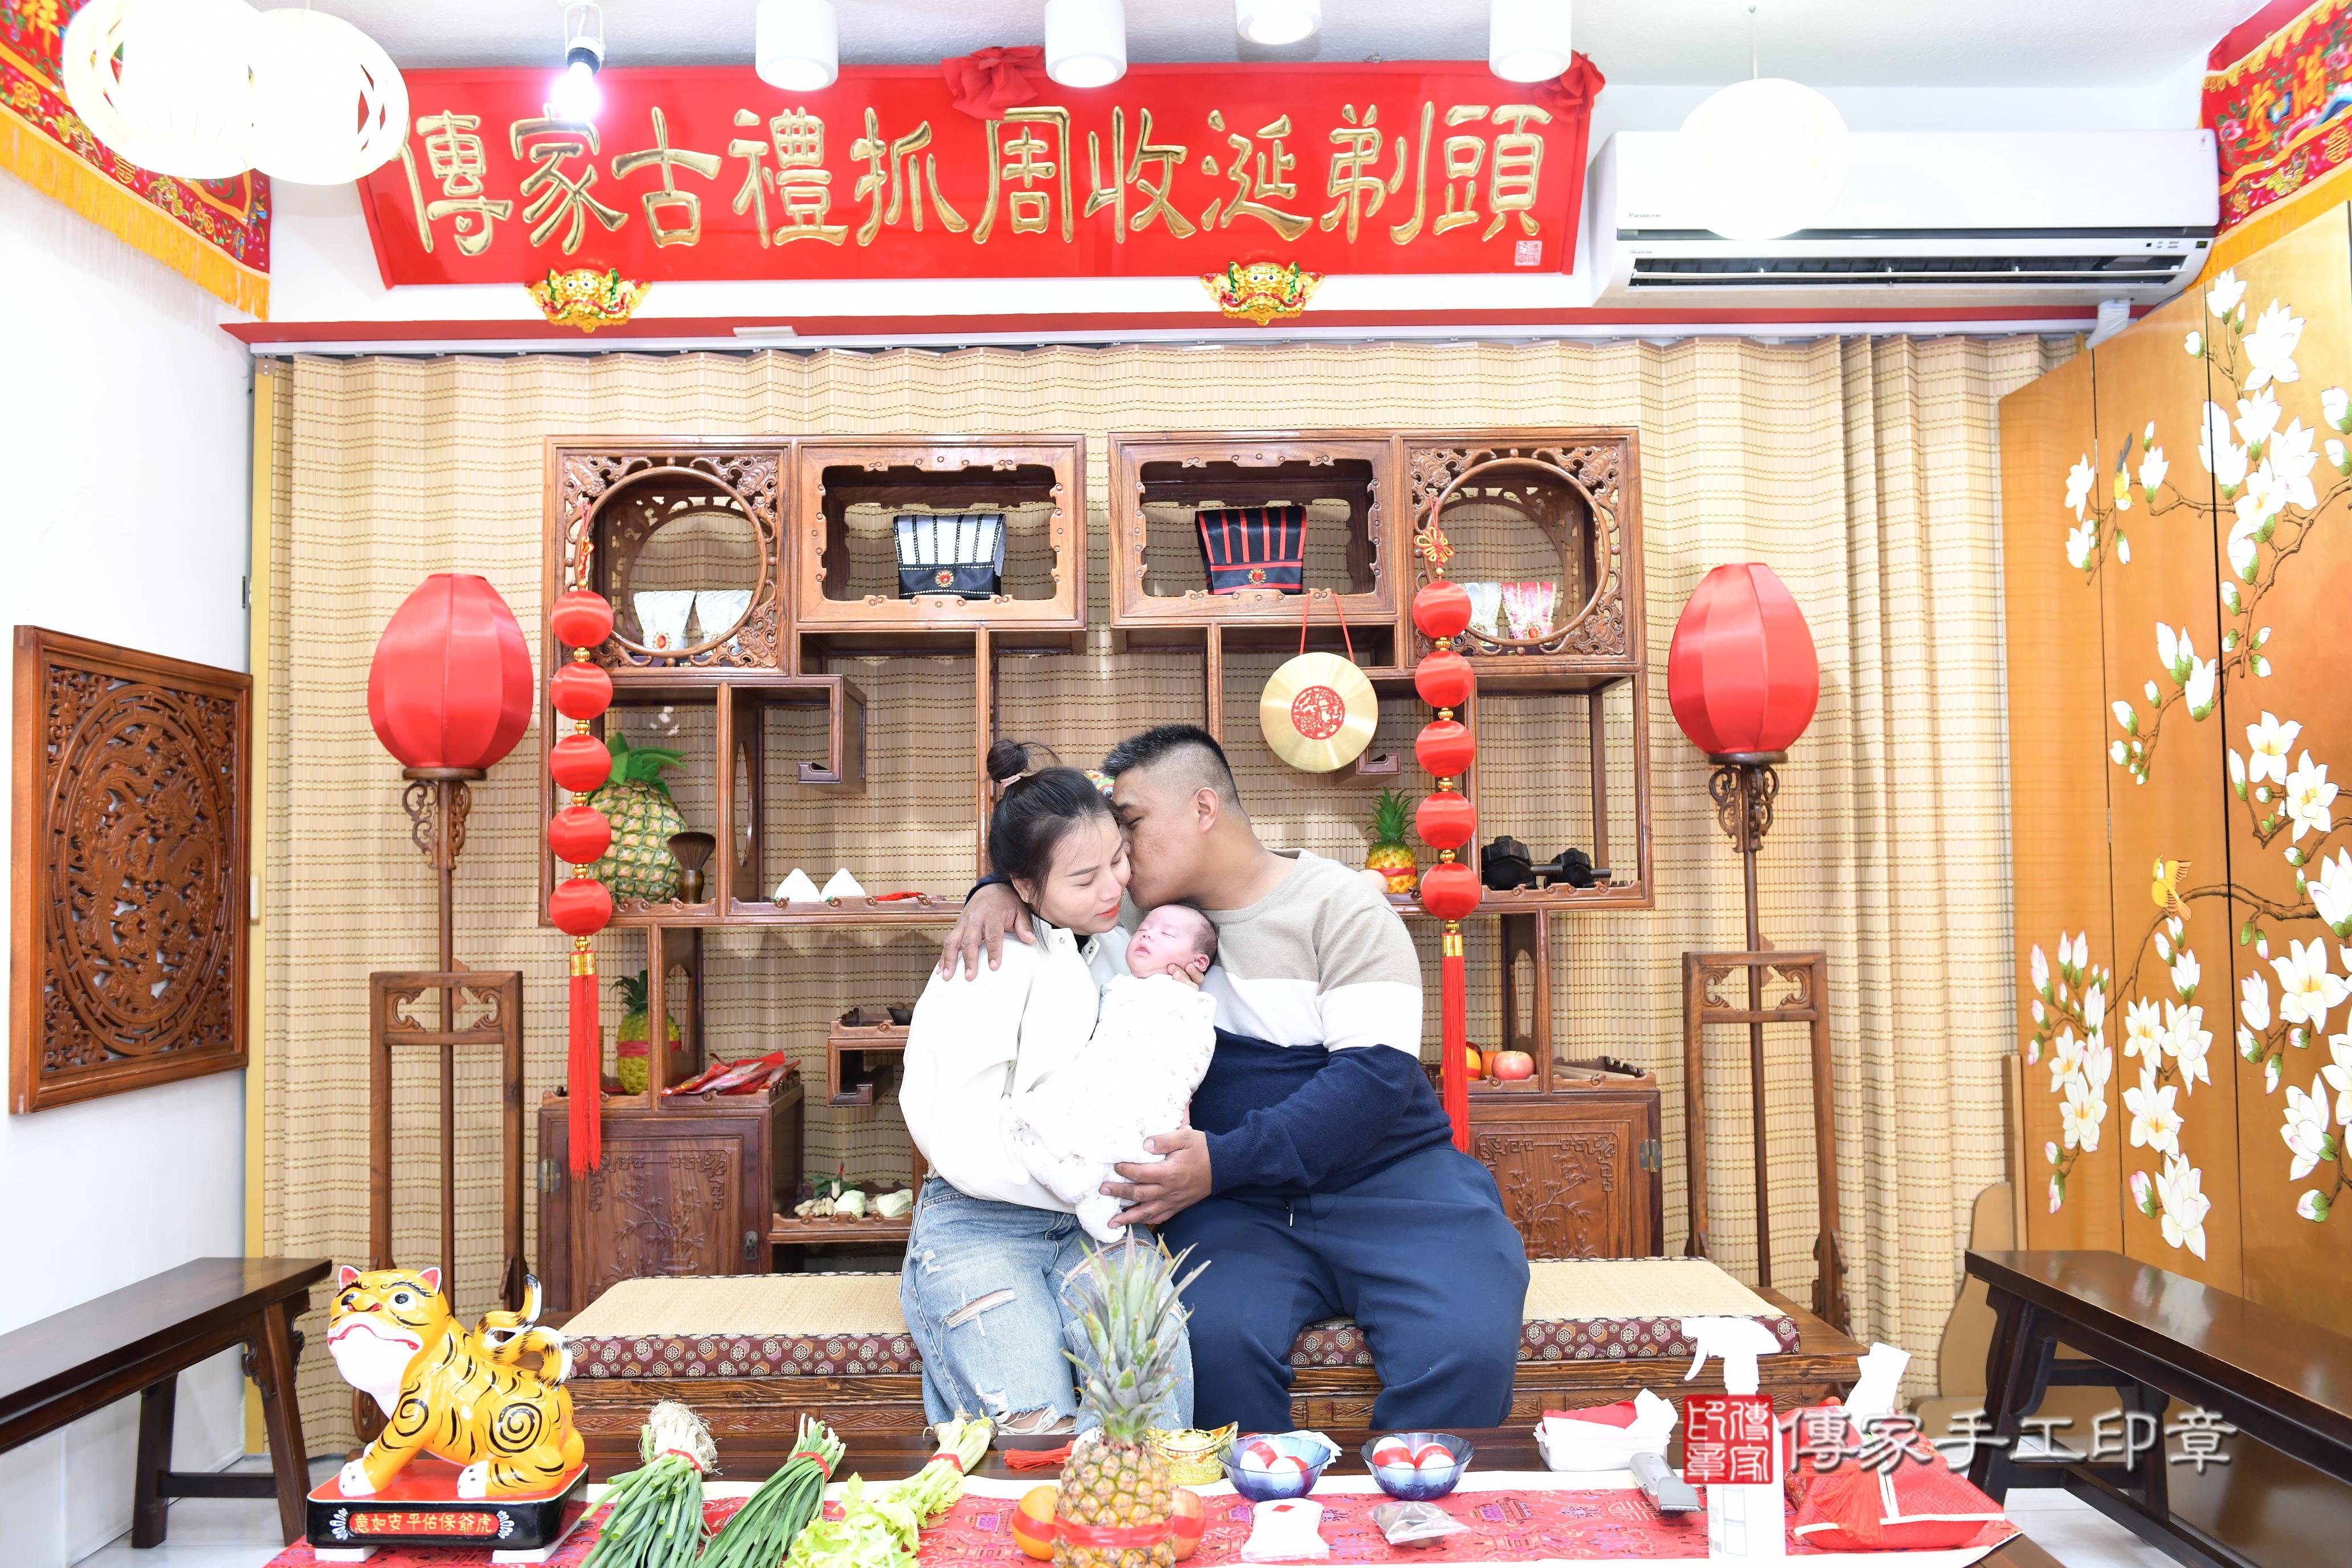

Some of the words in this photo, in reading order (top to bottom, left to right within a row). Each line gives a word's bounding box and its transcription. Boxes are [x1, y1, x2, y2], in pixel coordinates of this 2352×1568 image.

[390, 101, 1553, 256] 傳家古禮抓周收涎剃頭
